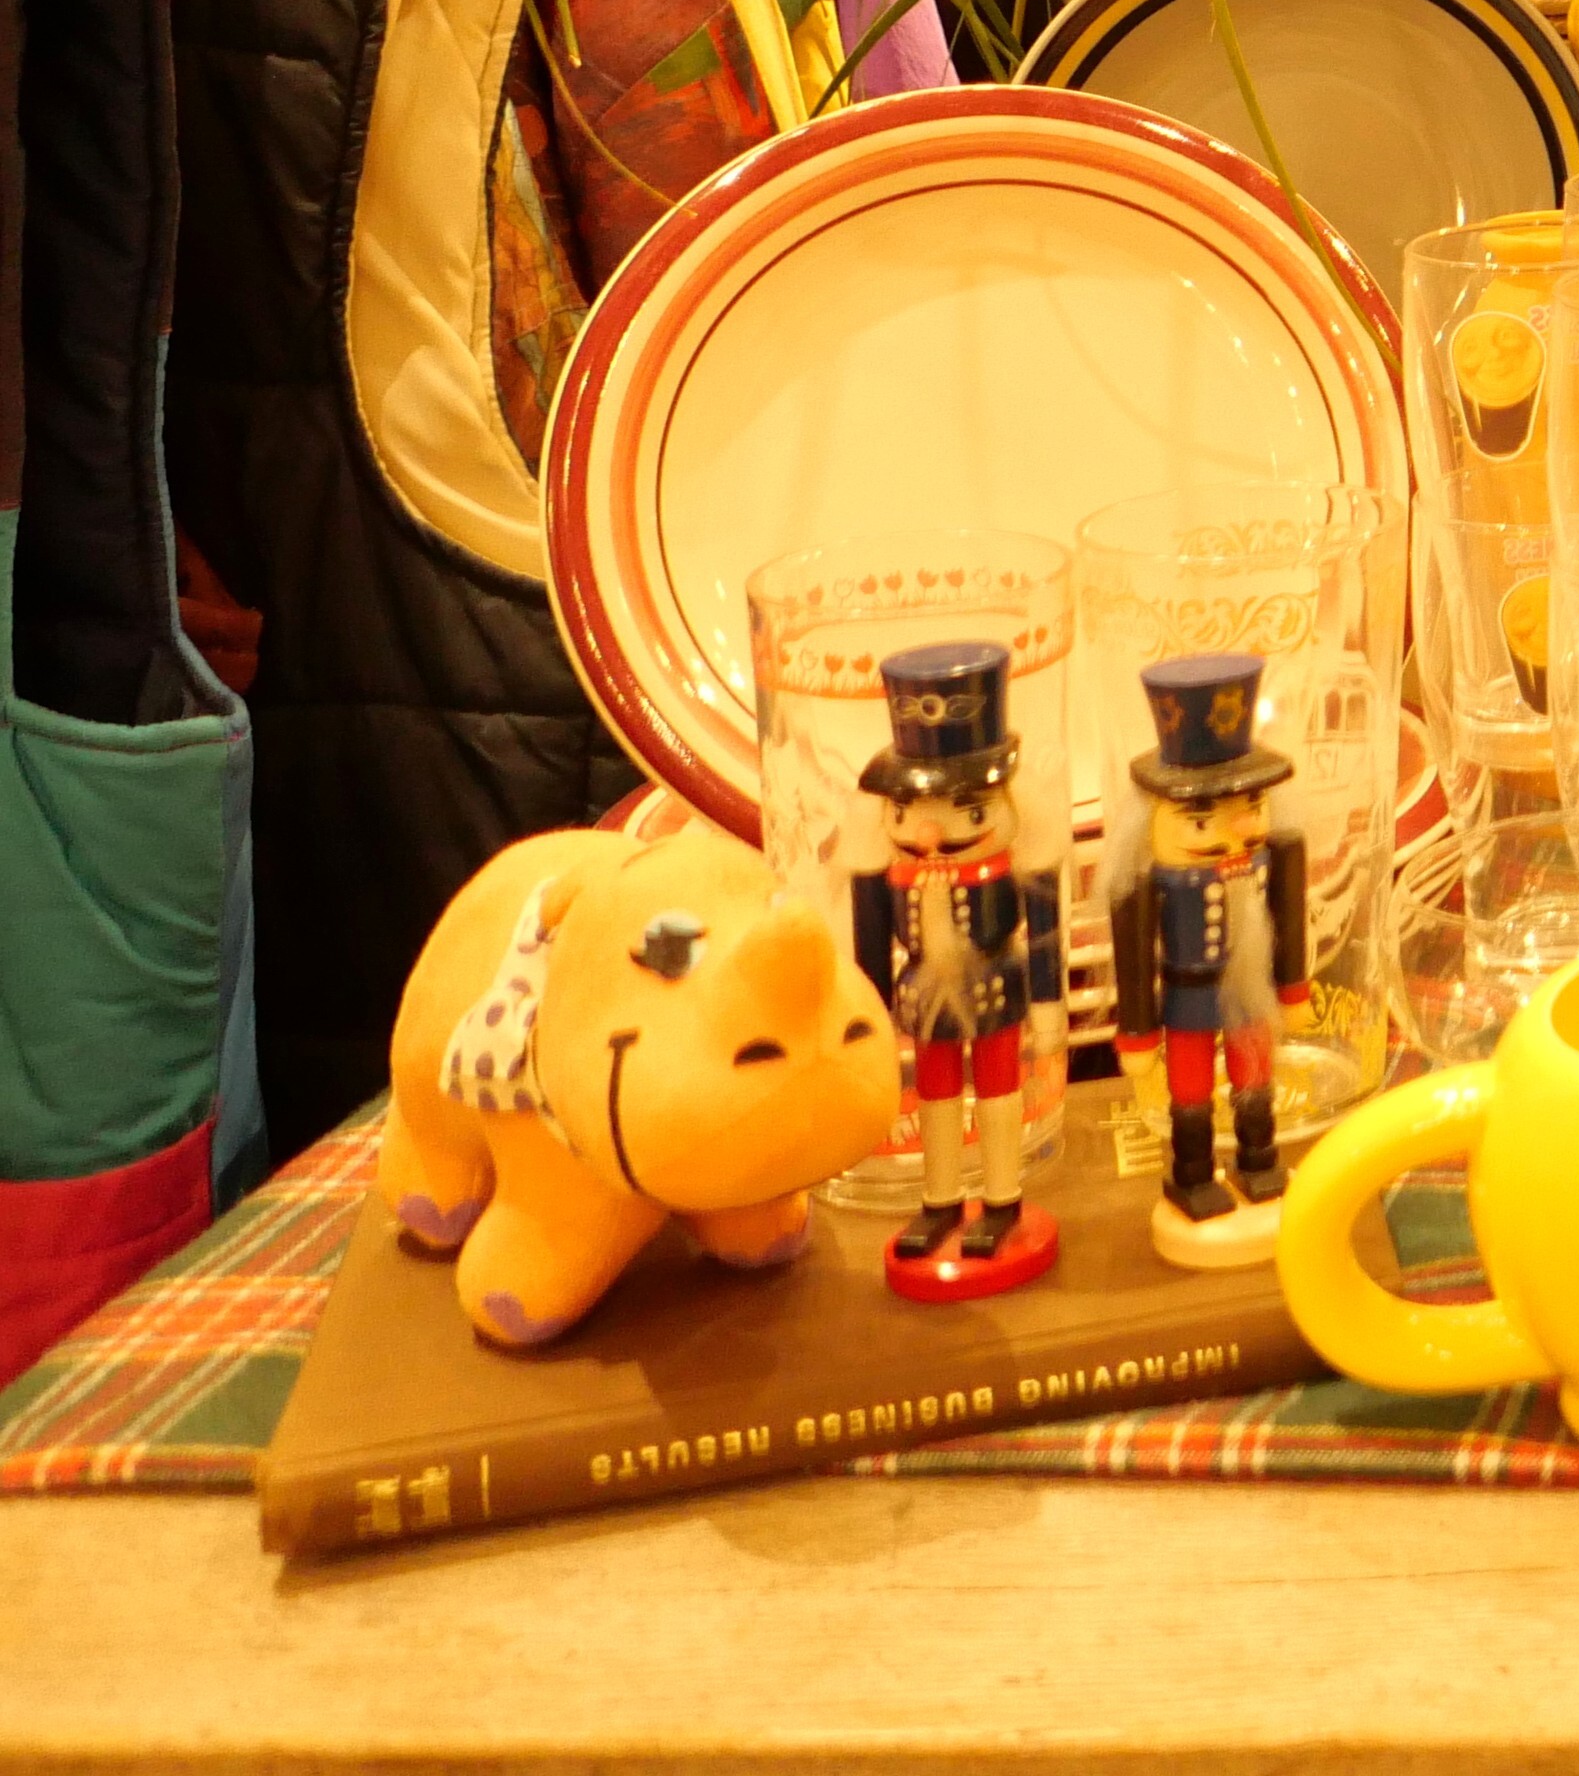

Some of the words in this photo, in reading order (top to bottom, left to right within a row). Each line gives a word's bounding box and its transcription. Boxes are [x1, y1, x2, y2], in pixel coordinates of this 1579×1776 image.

[1018, 1342, 1239, 1405] IMPROVING
[796, 1385, 993, 1446] BUSINESS
[589, 1424, 770, 1485] RESULTS
